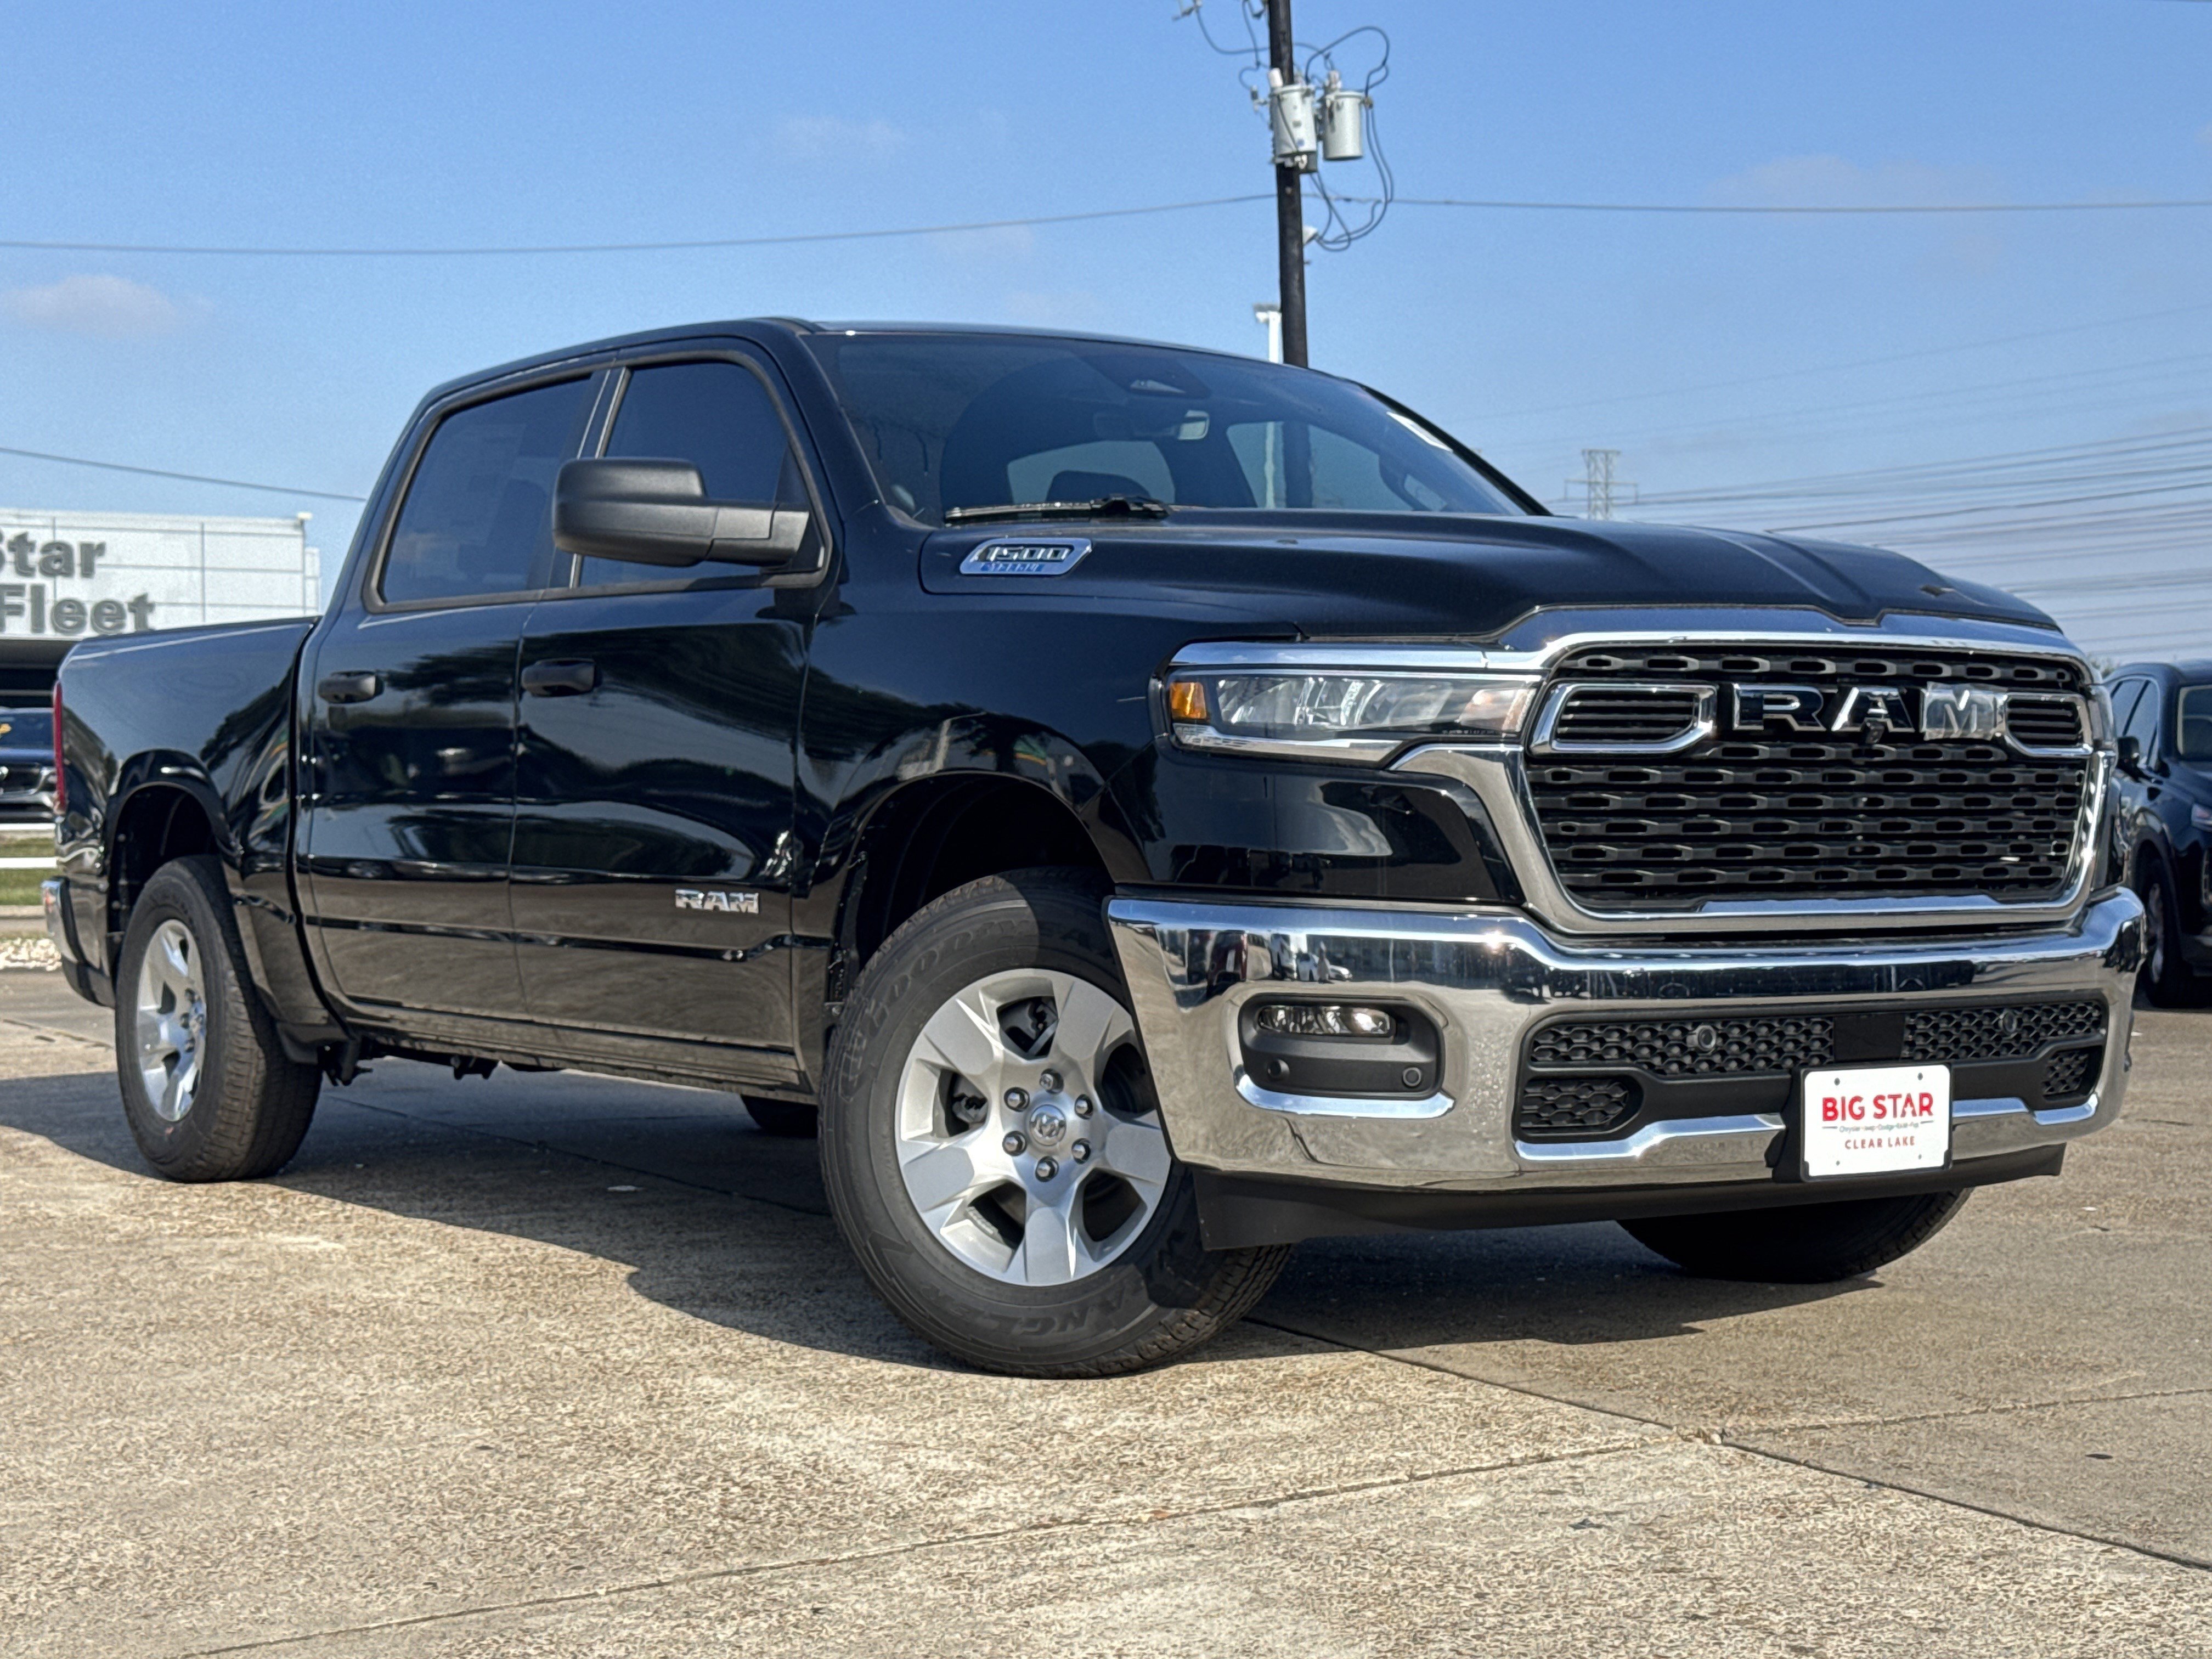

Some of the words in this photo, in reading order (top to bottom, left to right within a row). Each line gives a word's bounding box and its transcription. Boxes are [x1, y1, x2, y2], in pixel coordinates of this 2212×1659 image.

[0, 530, 106, 578] tar
[0, 583, 155, 634] Fleet
[1733, 682, 1997, 736] RAM
[675, 889, 759, 914] RAM
[1822, 1096, 1865, 1121] BIG
[1872, 1093, 1934, 1119] STAR
[1844, 1137, 1883, 1150] CLEAR
[1888, 1136, 1915, 1148] LAKE
